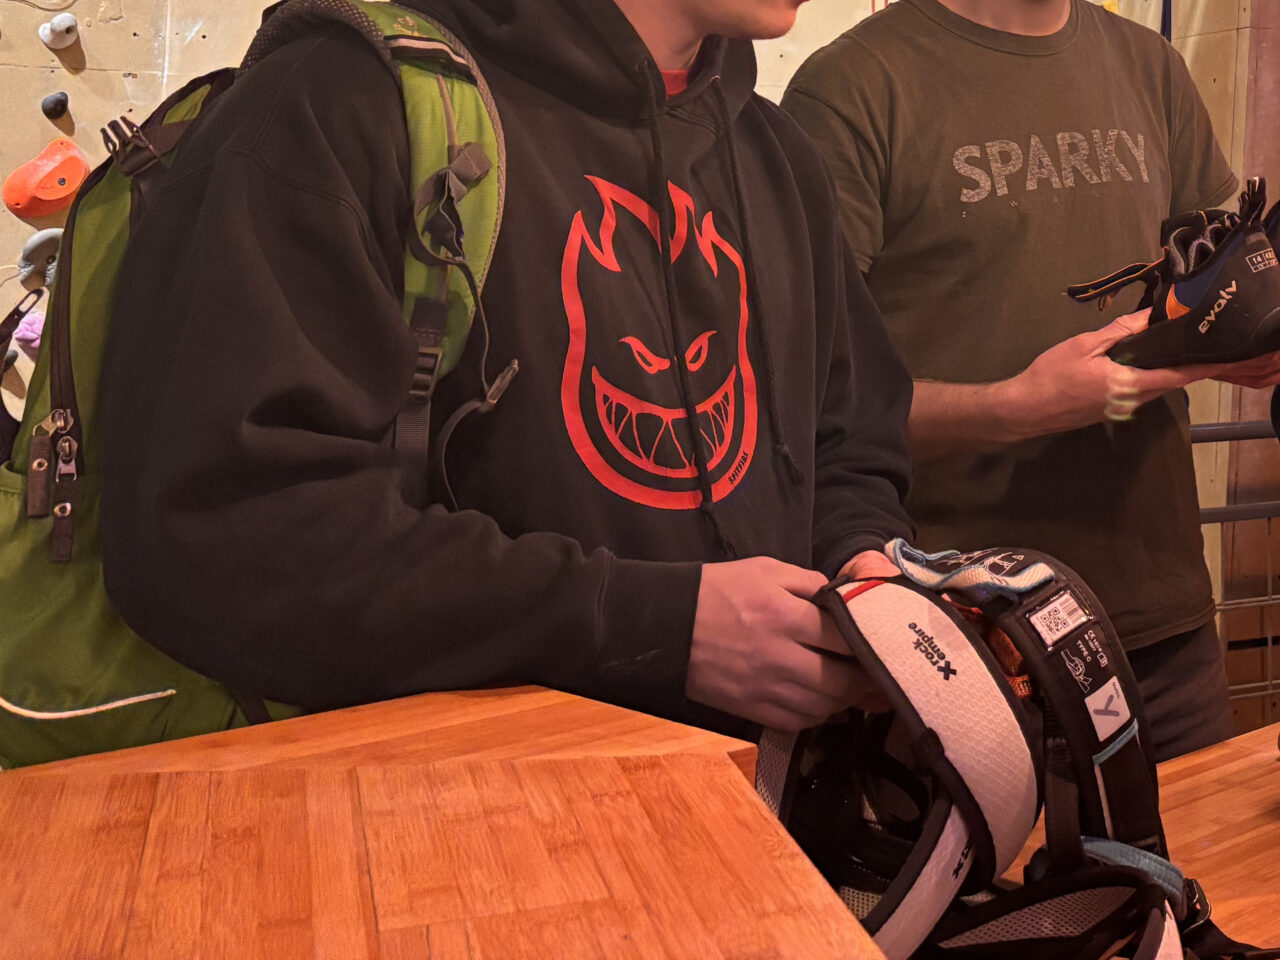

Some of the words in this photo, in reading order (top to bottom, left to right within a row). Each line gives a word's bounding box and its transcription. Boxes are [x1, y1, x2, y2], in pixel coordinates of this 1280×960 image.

[952, 129, 1150, 203] SPARKY
[1252, 256, 1262, 264] 14
[1198, 280, 1236, 334] evolv
[908, 622, 946, 660] empire
[912, 638, 940, 666] rock
[1077, 640, 1089, 657] TYPE
